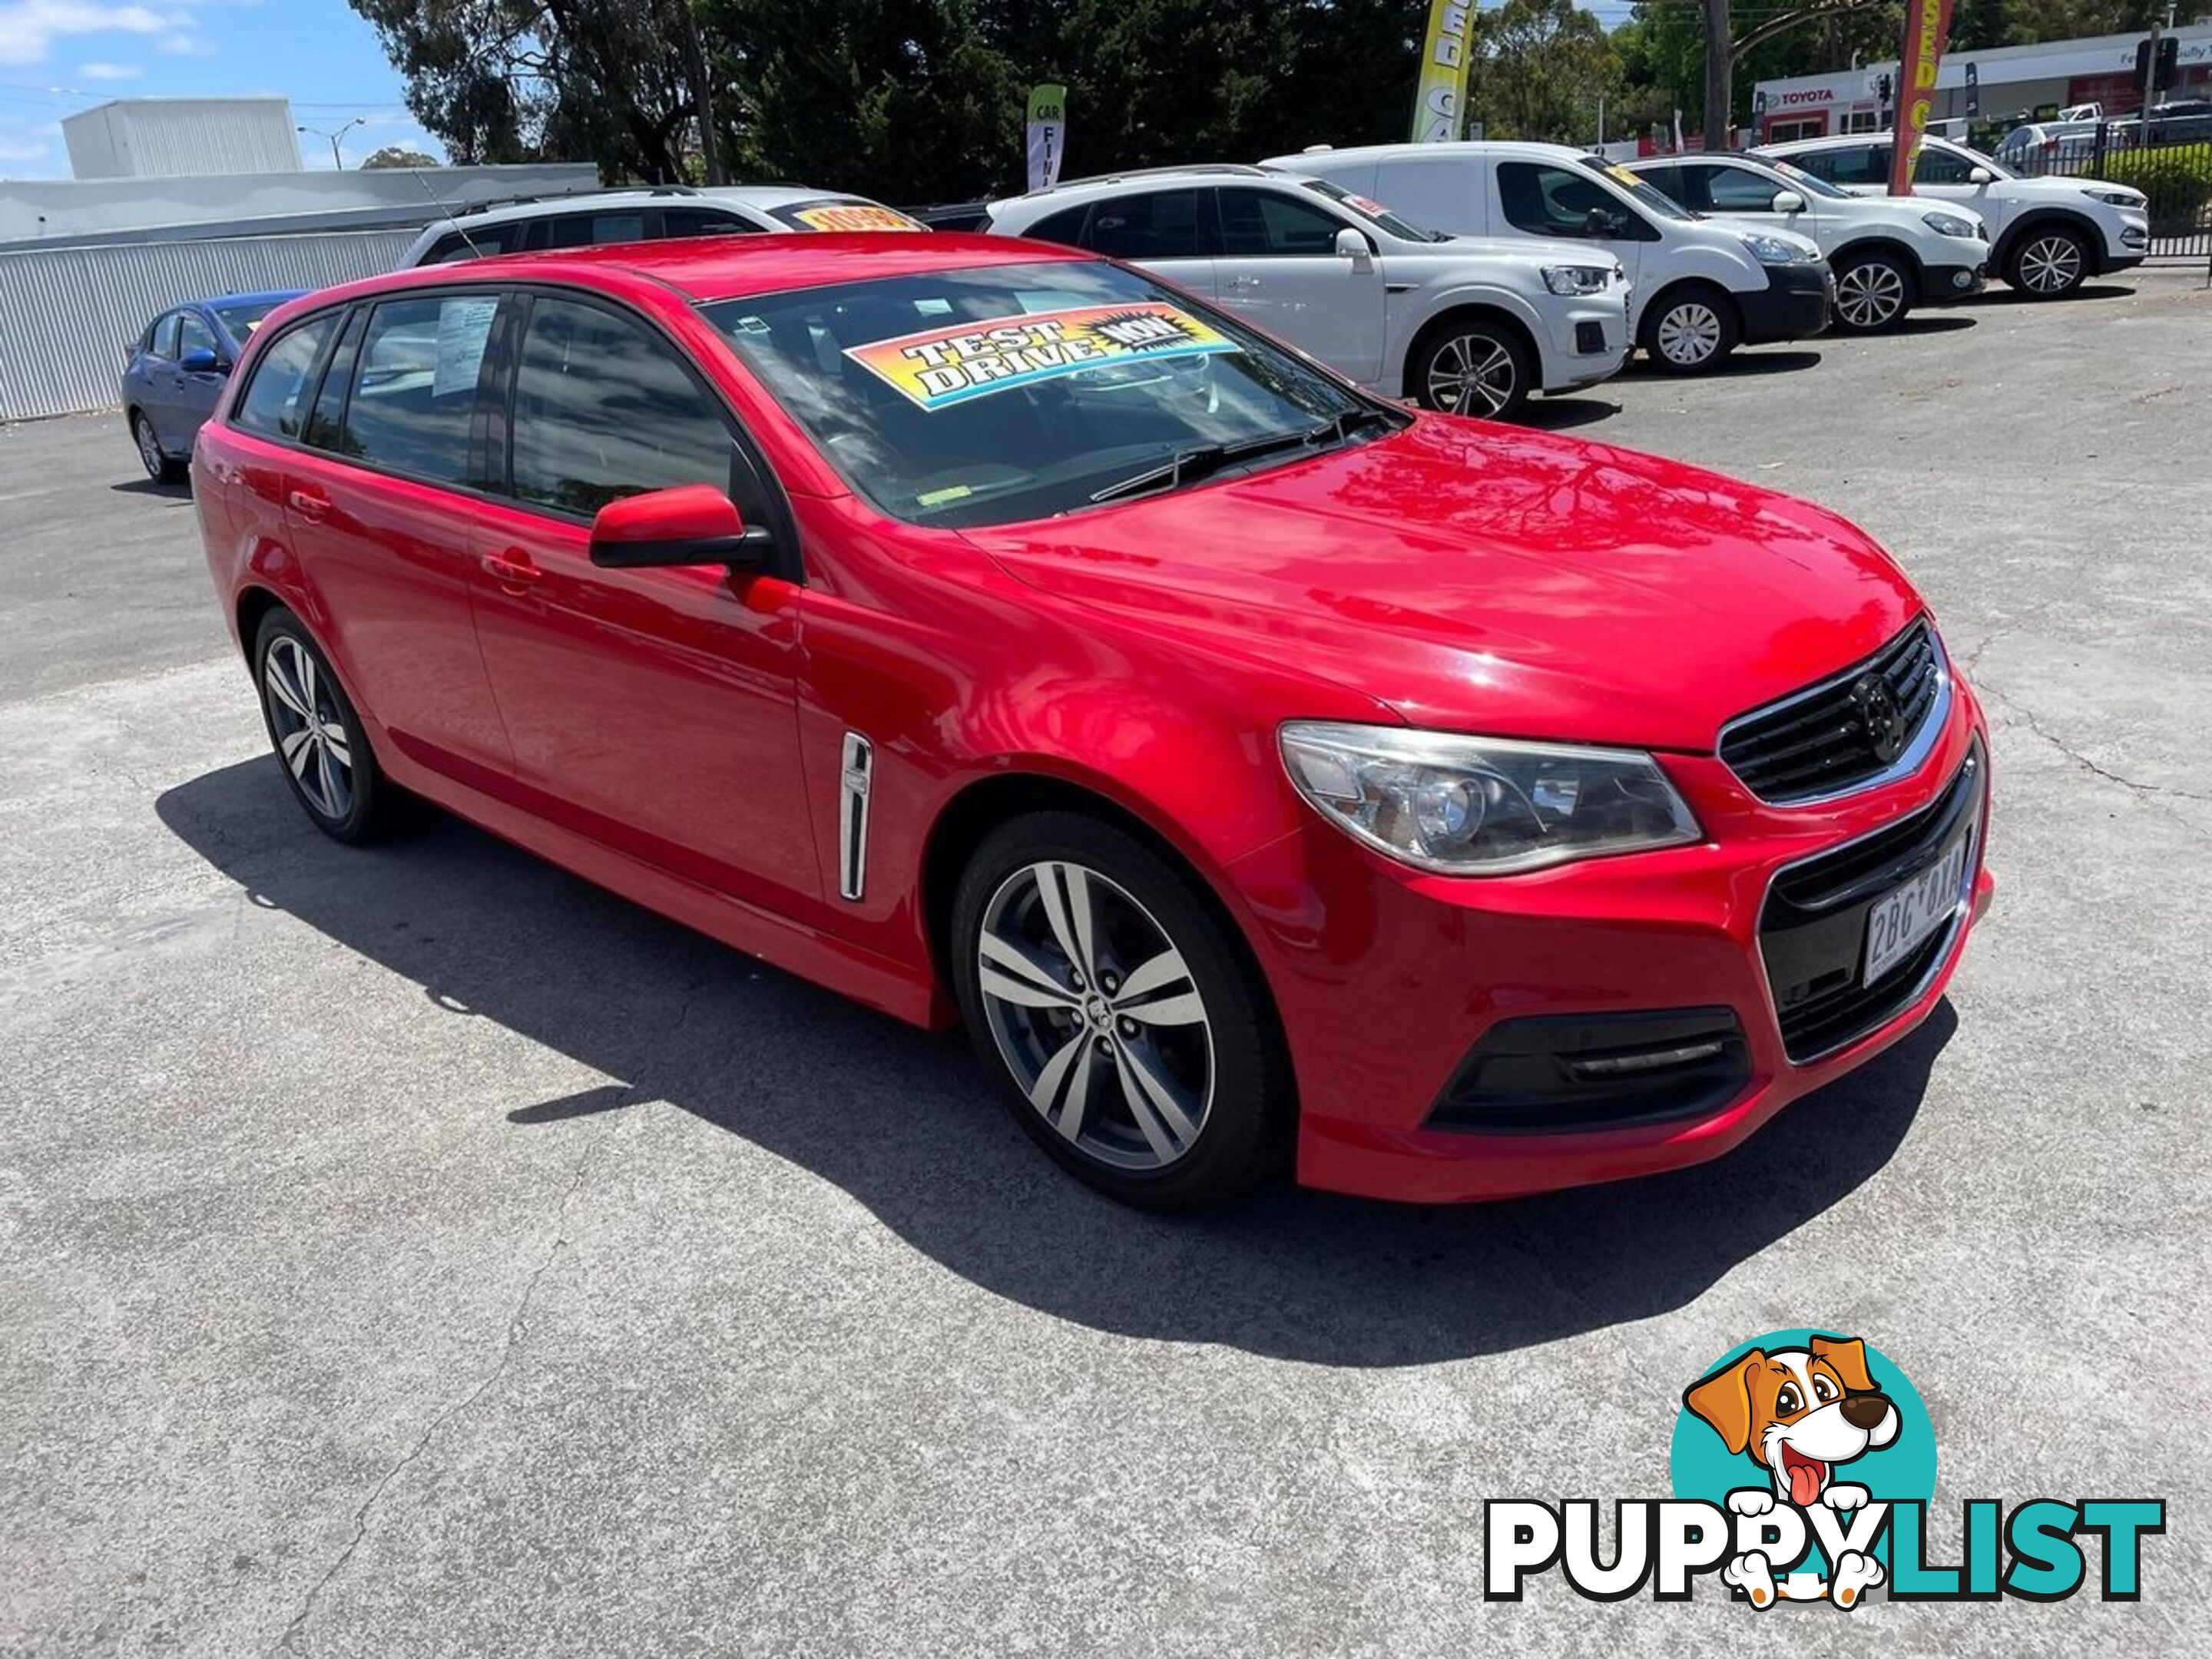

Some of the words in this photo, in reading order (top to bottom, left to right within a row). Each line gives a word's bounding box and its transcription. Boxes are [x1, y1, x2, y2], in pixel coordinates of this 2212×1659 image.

[1782, 90, 1833, 104] TOYOTA
[1036, 105, 1059, 120] CAR
[902, 320, 1065, 367] TEST
[1102, 316, 1179, 344] NOW
[915, 337, 1110, 396] DRIVE
